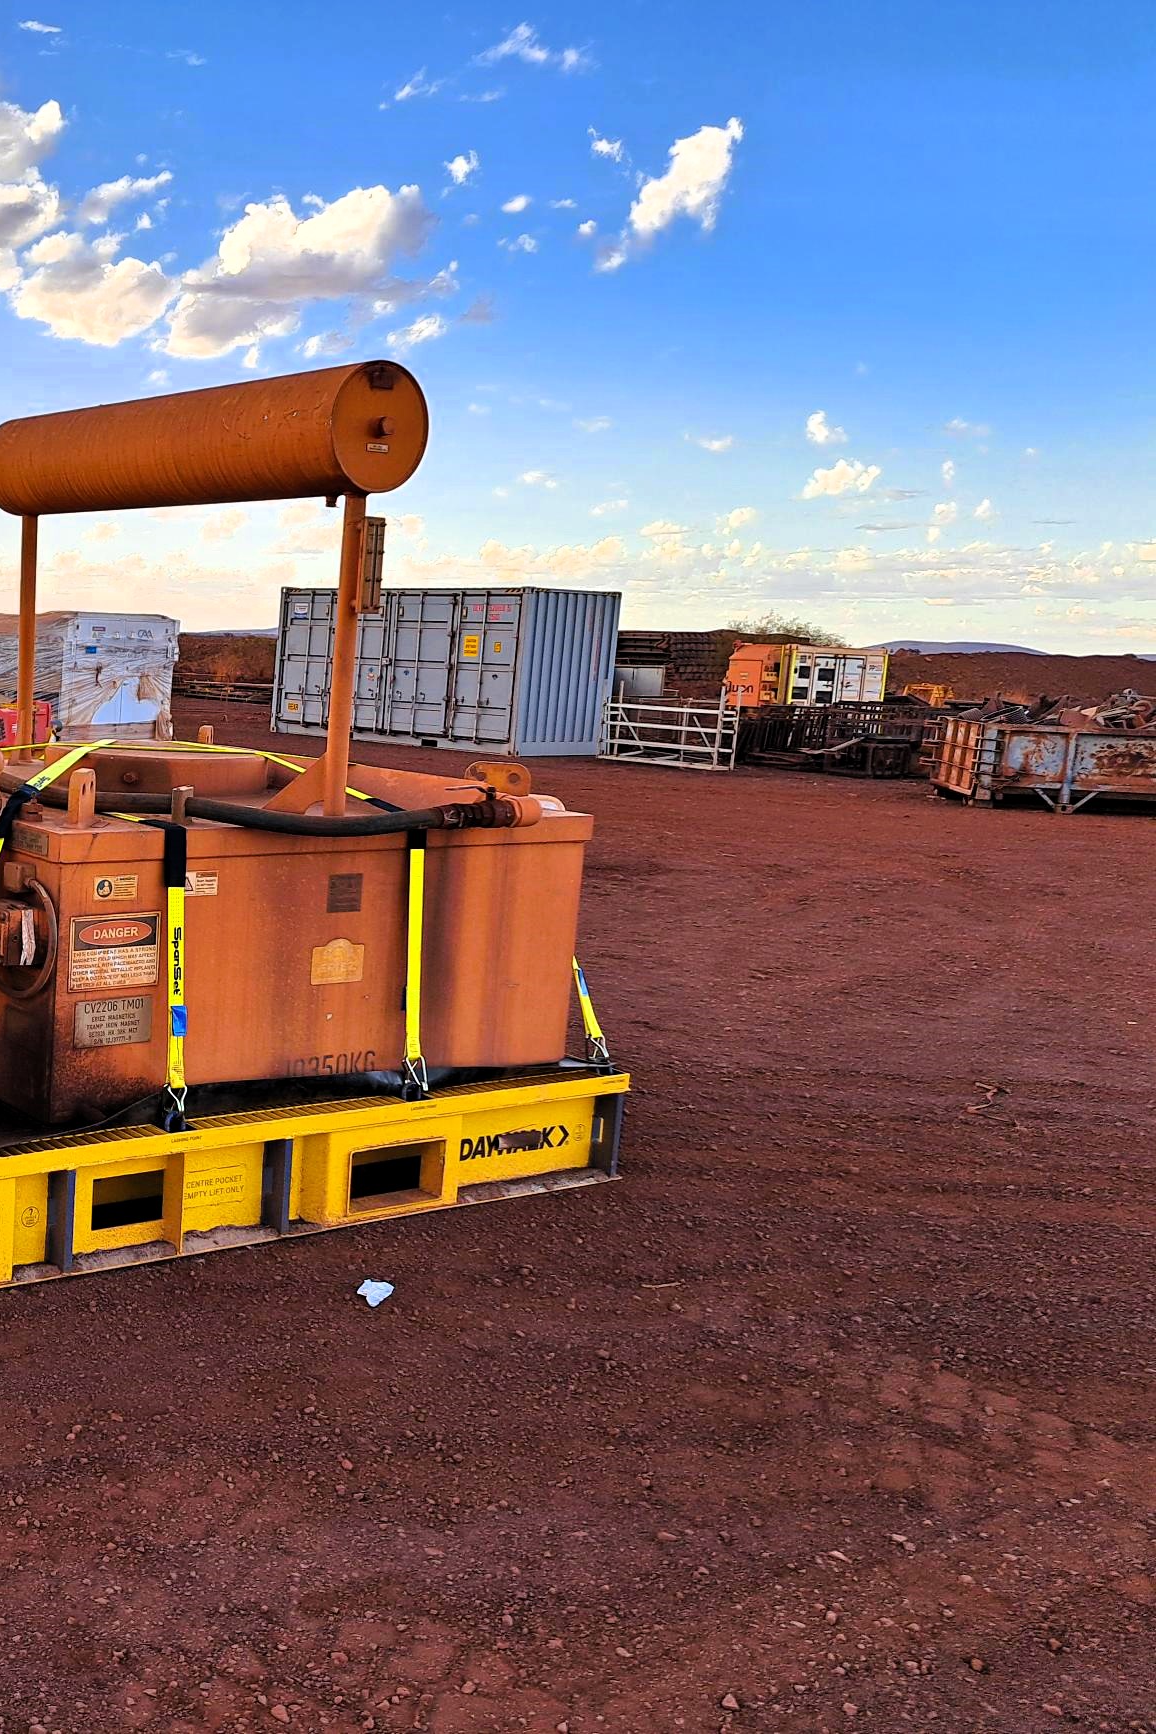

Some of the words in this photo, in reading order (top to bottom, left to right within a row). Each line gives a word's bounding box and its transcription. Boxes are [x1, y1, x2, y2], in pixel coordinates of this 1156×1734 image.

[93, 926, 139, 940] DANGER
[171, 927, 182, 995] SpanSet
[84, 1000, 118, 1014] CV2206
[121, 998, 144, 1010] TM01
[459, 1126, 557, 1161] DAYK
[186, 1178, 214, 1189] CENTRE
[215, 1174, 243, 1185] POCKET
[184, 1190, 208, 1200] EMPTY
[209, 1187, 224, 1197] LIFT
[225, 1185, 245, 1194] ONLY
